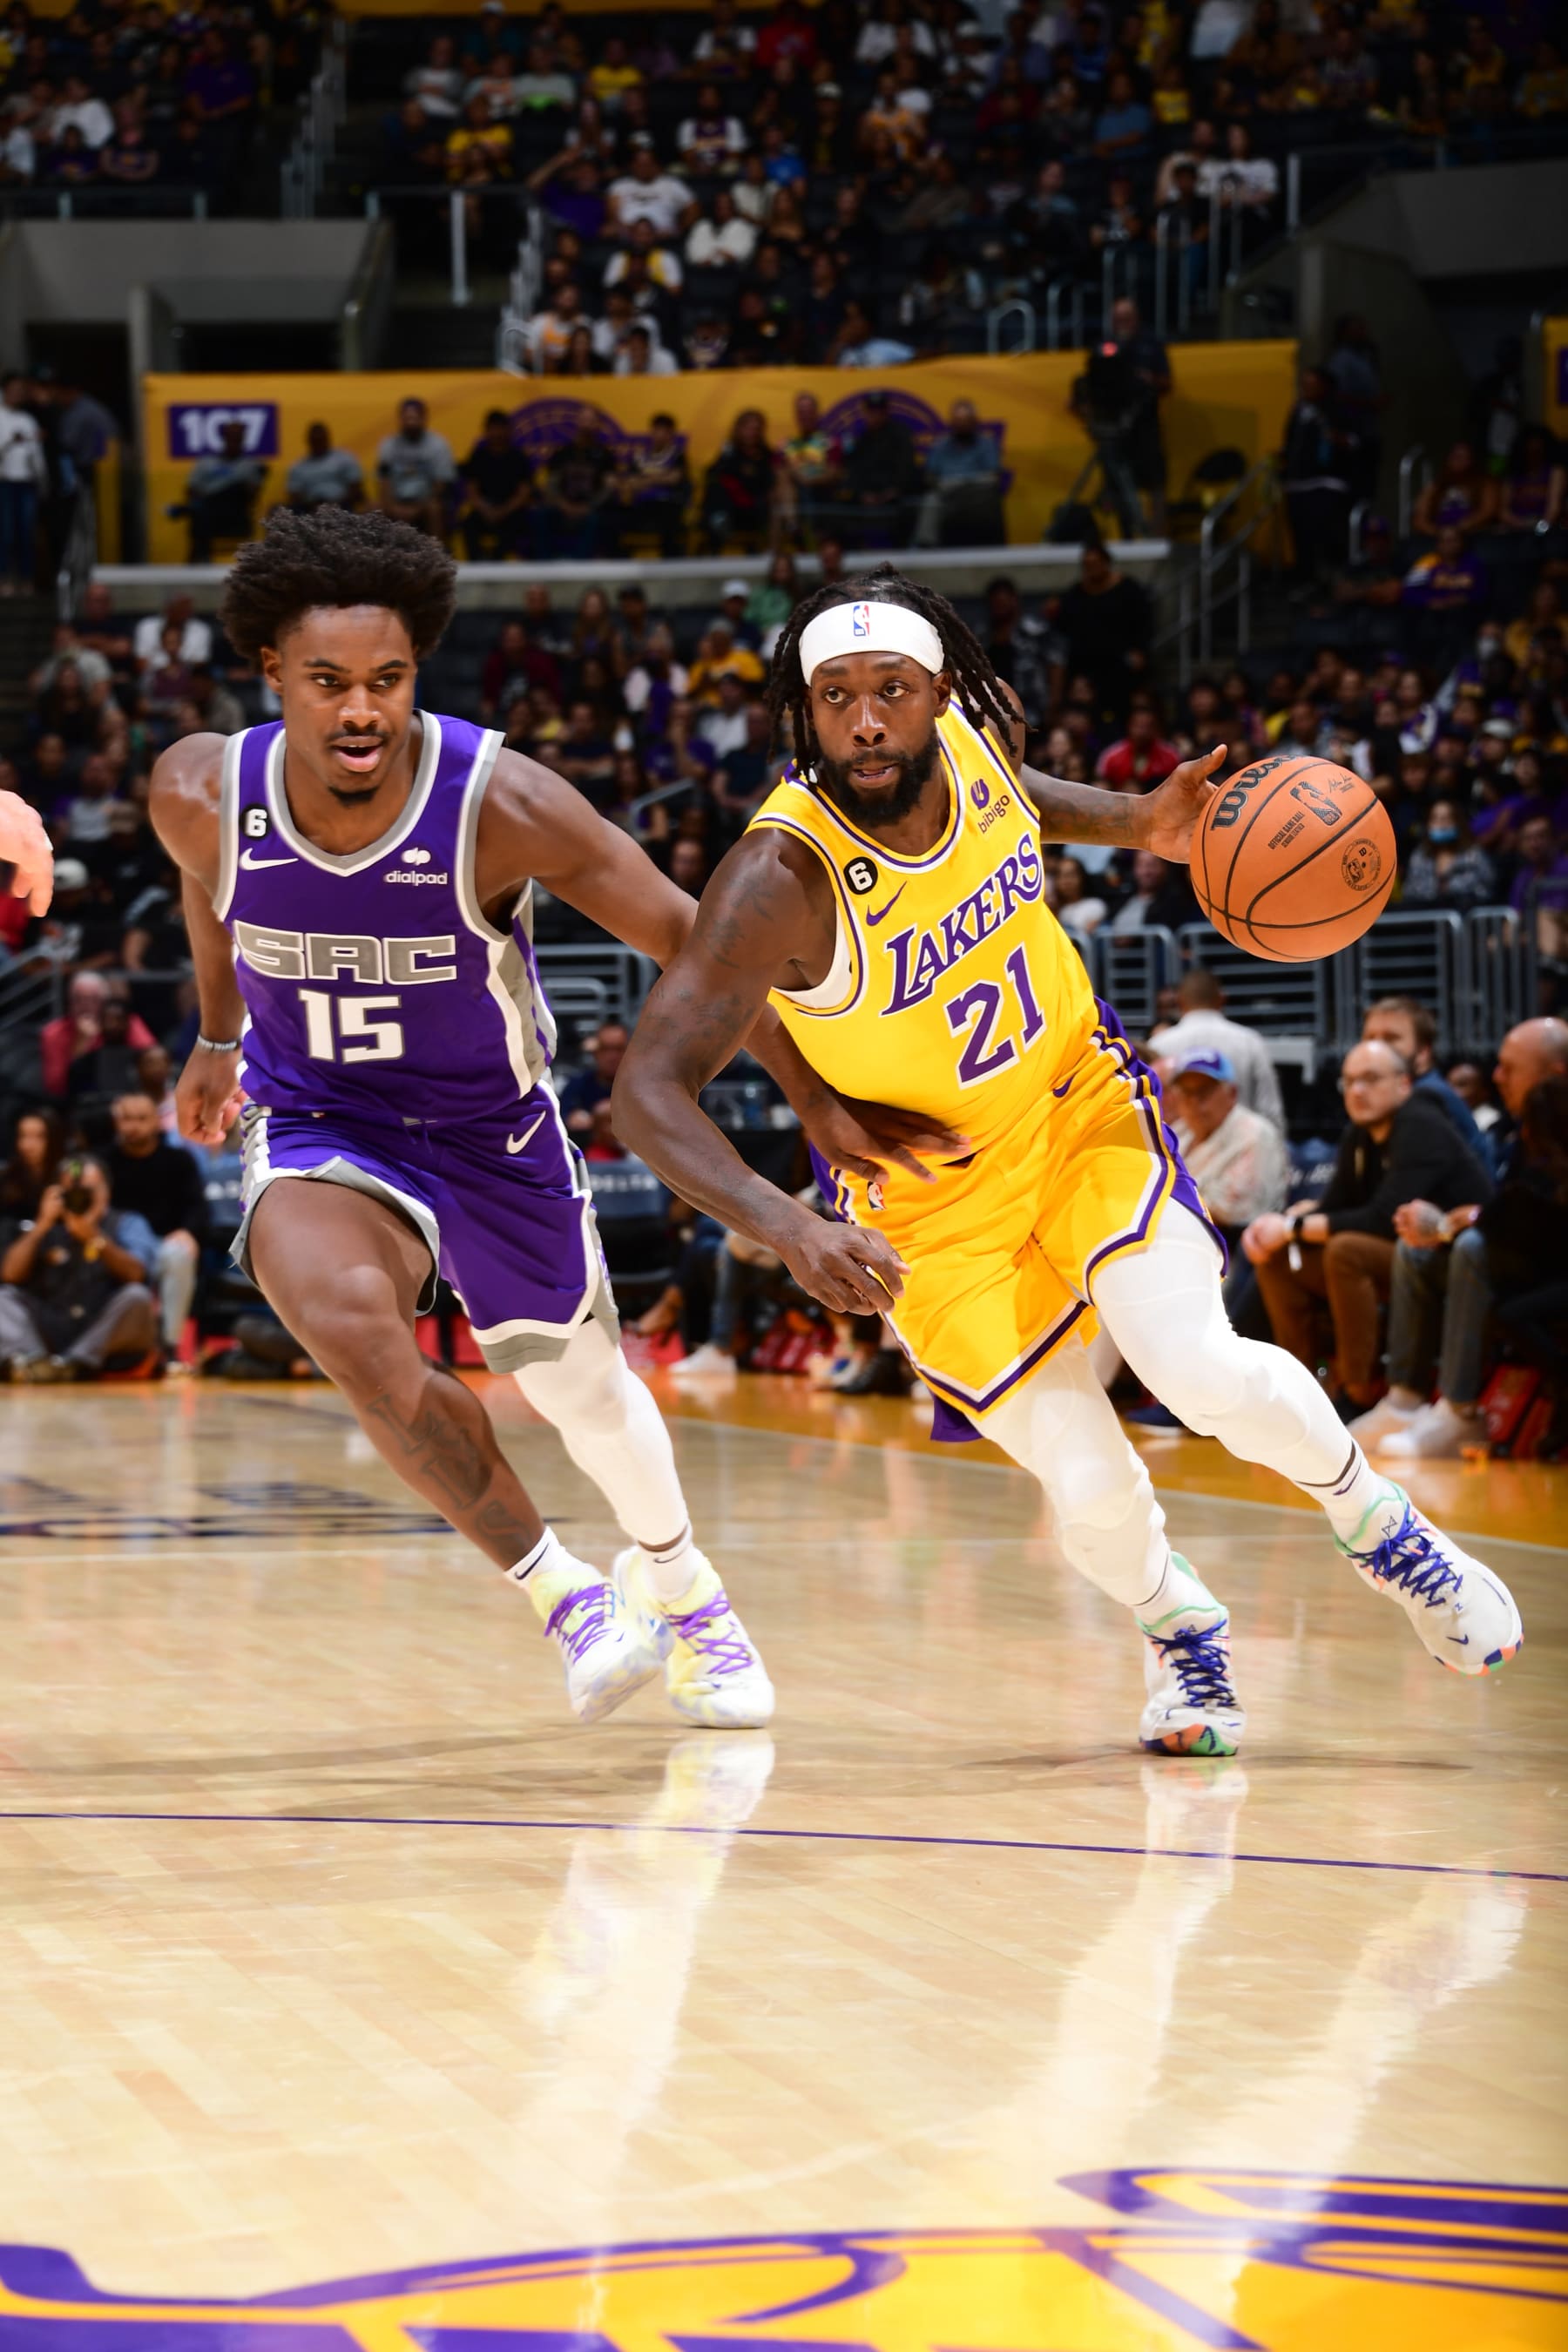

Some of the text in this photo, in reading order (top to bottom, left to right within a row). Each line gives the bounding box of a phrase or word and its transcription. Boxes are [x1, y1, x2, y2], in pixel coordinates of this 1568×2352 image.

[245, 808, 268, 838] 6
[977, 792, 1010, 835] bibigo
[383, 869, 449, 887] dialpad
[849, 861, 873, 890] 6
[878, 831, 1044, 1017] LAKERS
[233, 919, 458, 985] SAC
[297, 987, 404, 1065] 15
[943, 942, 1047, 1090] 21
